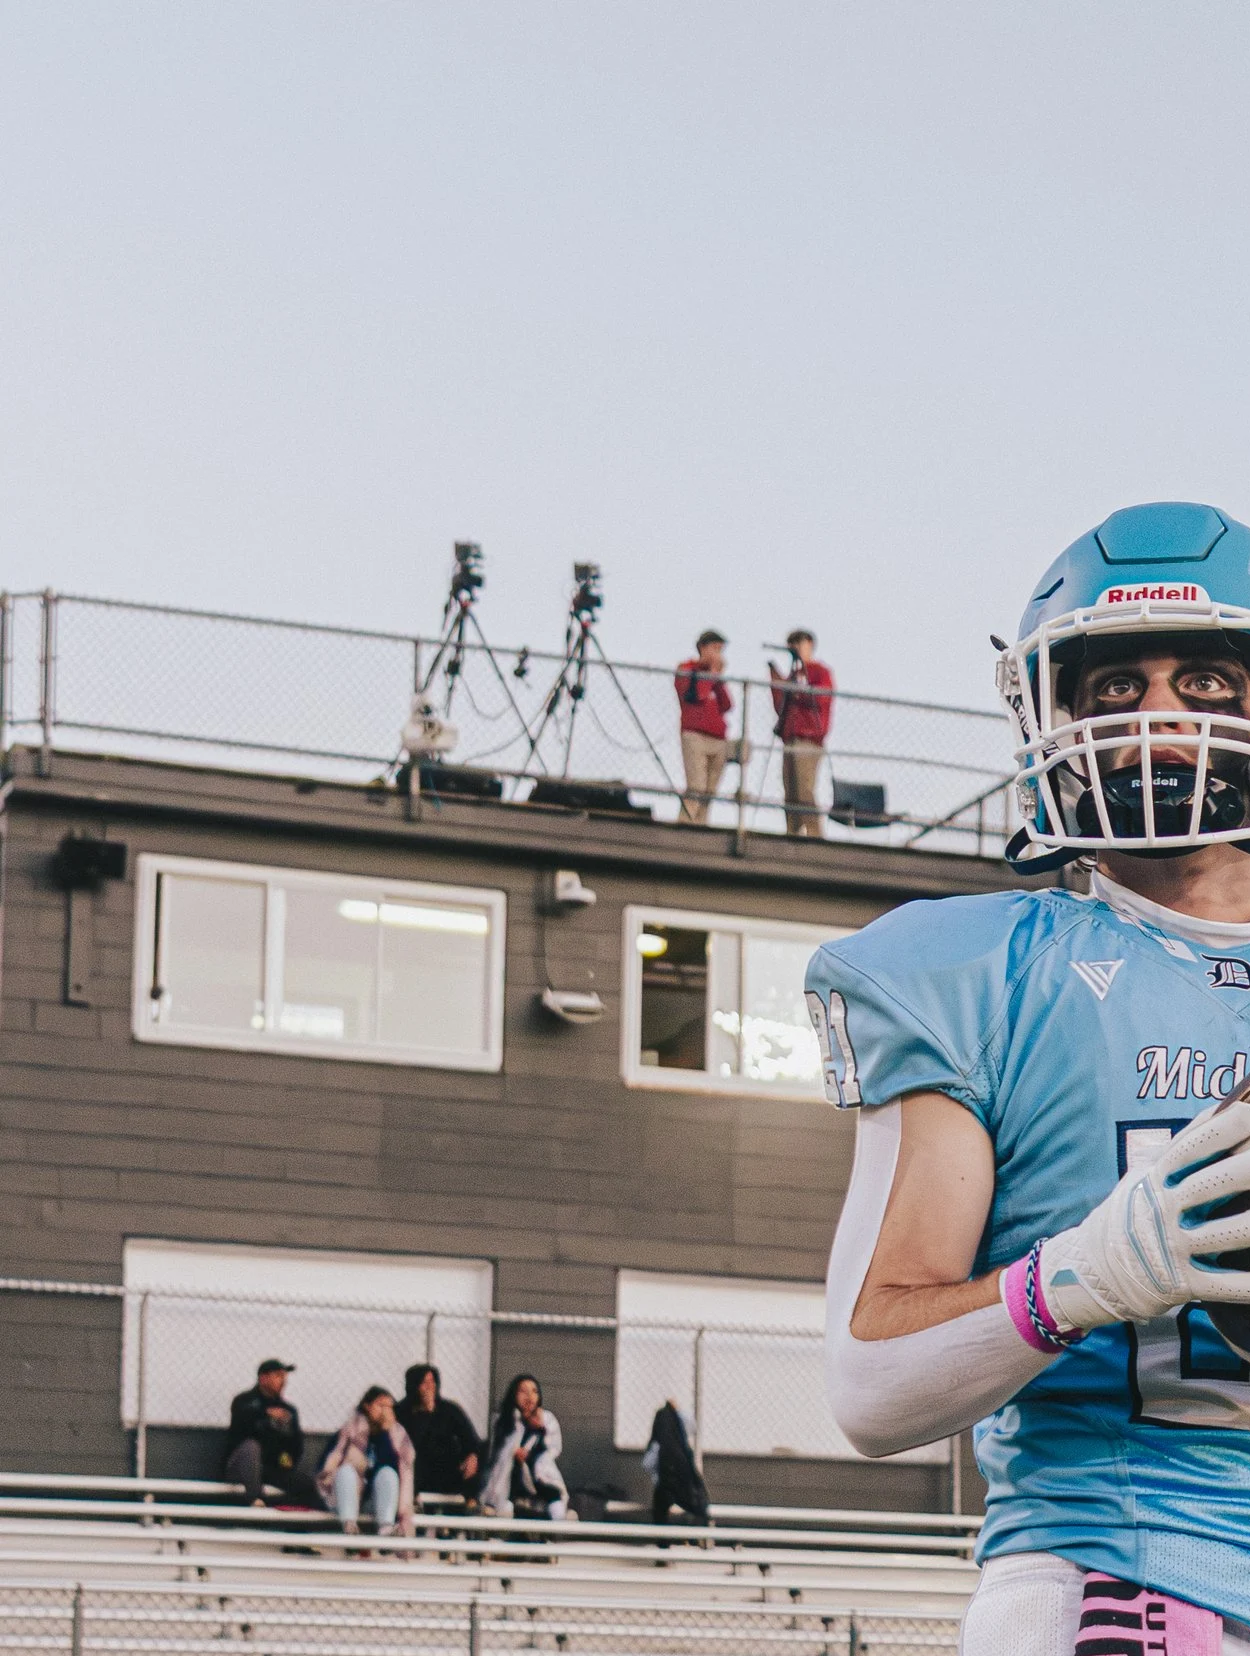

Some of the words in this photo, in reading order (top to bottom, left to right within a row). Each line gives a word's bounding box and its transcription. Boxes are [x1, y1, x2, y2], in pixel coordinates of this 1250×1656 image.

[1107, 585, 1197, 604] Riddell
[1130, 777, 1178, 788] Ridell
[1136, 1044, 1248, 1101] Mid
